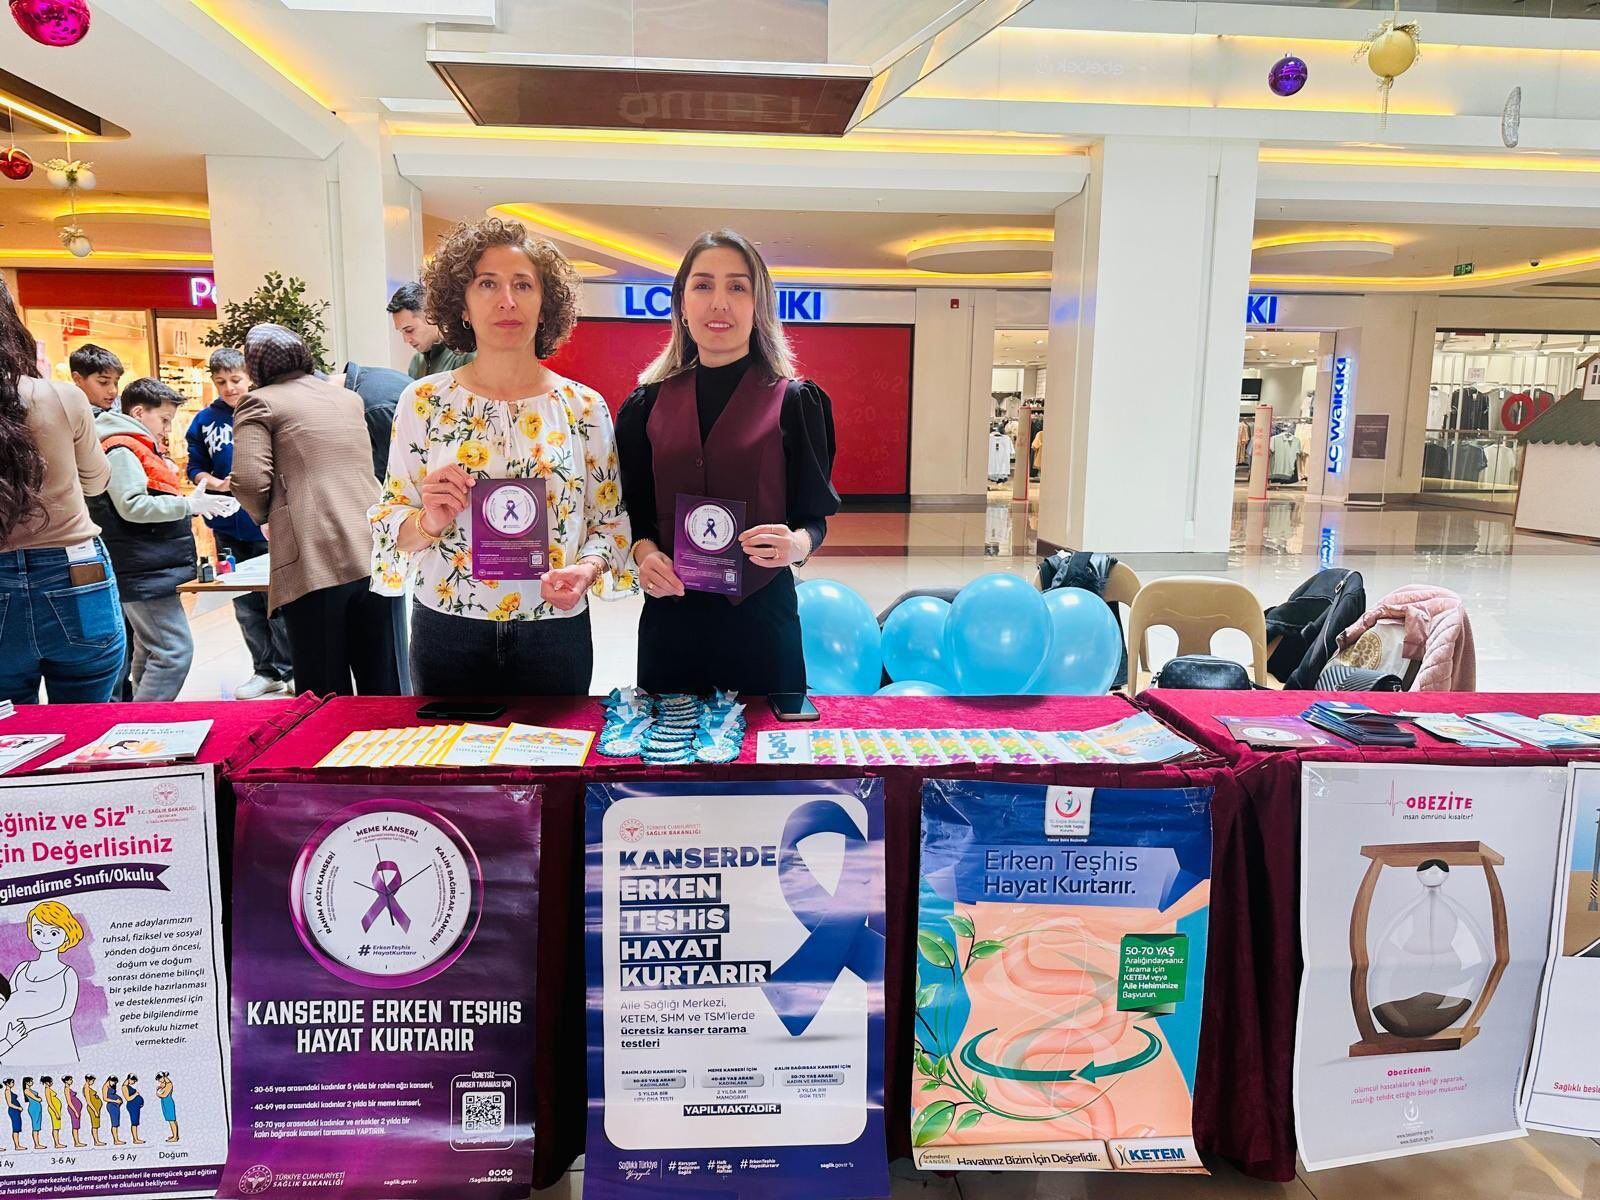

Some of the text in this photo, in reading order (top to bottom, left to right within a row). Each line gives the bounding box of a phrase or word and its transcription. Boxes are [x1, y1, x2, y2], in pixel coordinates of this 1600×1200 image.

[625, 287, 671, 316] LC
[1328, 444, 1338, 473] LC
[1406, 791, 1473, 811] OBEZİTE
[62, 815, 87, 830] ve
[356, 826, 418, 837] MEME KANSERİ
[32, 833, 173, 865] Değerlisiniz
[435, 846, 451, 869] KALIN
[620, 846, 776, 870] KANSERDE
[985, 850, 1138, 876] Erken Teşhis
[318, 851, 337, 885] KANSERİ
[74, 868, 154, 888] Sınıfı/Okulu
[447, 871, 456, 904] BAĞIRSAK
[621, 876, 717, 901] ERKEN
[984, 875, 1135, 898] Hayat Kurtarır.
[110, 916, 193, 929] Anne adaylarımızın
[316, 907, 332, 934] RAHİM
[429, 904, 454, 946] KANSERİ
[621, 908, 726, 933] TEŞHİS
[102, 934, 130, 943] ruhsal,
[133, 932, 161, 941] fiziksel
[176, 928, 202, 939] sosyal
[104, 942, 201, 958] yönden doğum öncesi,
[622, 938, 718, 960] HAYAT
[1125, 946, 1175, 957] 50-70 YAŞ
[116, 960, 147, 969] doğum
[161, 957, 192, 966] doğum
[1125, 957, 1184, 965] Aralığındaysanız
[140, 971, 175, 980] döneme
[177, 968, 205, 977] bilinçli
[622, 964, 767, 987] KURTARIR
[109, 981, 207, 995] bir şekilde hazırlanması
[126, 997, 186, 1006] desteklenmesi
[188, 995, 203, 1004] için
[1122, 991, 1157, 999] Başvurun.
[621, 998, 727, 1012] Aile Sağlığı Merkezi,
[120, 1009, 199, 1022] gebe bilgilendirme
[247, 1000, 522, 1026] KANSERDE ERKEN TEŞHİS
[620, 1011, 755, 1023] KETEM, SHM ve TSM'lerde
[121, 1025, 168, 1034] sınıfı/okulu
[621, 1026, 746, 1035] ücretsiz kanser tarama
[135, 1036, 187, 1046] vermektedir.
[297, 1028, 474, 1053] HAYAT KURTARIR
[621, 1038, 660, 1048] testleri
[1387, 1066, 1431, 1076] Obezitenin
[254, 1085, 274, 1093] 30-65
[275, 1086, 286, 1094] yaş
[287, 1084, 319, 1092] arasındaki
[321, 1083, 346, 1091] kadınlar
[353, 1082, 367, 1091] yılda
[368, 1082, 376, 1090] bir
[378, 1082, 395, 1090] rahim
[396, 1082, 408, 1091] ağzı
[1553, 1082, 1581, 1093] Sağlıklı
[254, 1103, 274, 1111] 40-69
[275, 1103, 286, 1111] yaş
[287, 1102, 320, 1110] arasındaki
[321, 1101, 346, 1109] kadınlar
[352, 1100, 367, 1108] yılda
[685, 1104, 780, 1115] YAPILMAKTADIR.
[286, 1119, 319, 1127] arasındaki
[320, 1119, 344, 1127] kadınlar
[354, 1118, 380, 1126] erkekler
[381, 1117, 385, 1125] 2
[386, 1117, 401, 1125] yılda
[254, 1130, 269, 1138] kalın
[270, 1130, 297, 1139] bağırsak
[50, 1156, 76, 1165] 3-6 Ay
[111, 1153, 137, 1161] 6-9 Ay
[159, 1151, 188, 1159] Doğum
[1005, 1155, 1032, 1165] Bizim
[1032, 1152, 1051, 1166] İçin
[1052, 1153, 1100, 1165] Değerlidir.
[1129, 1147, 1185, 1161] KETEM
[4, 1160, 15, 1168] Ay
[302, 1171, 345, 1179] CUMHURİYETİ
[273, 1179, 344, 1188] SAĞLIK BAKANLIĞI
